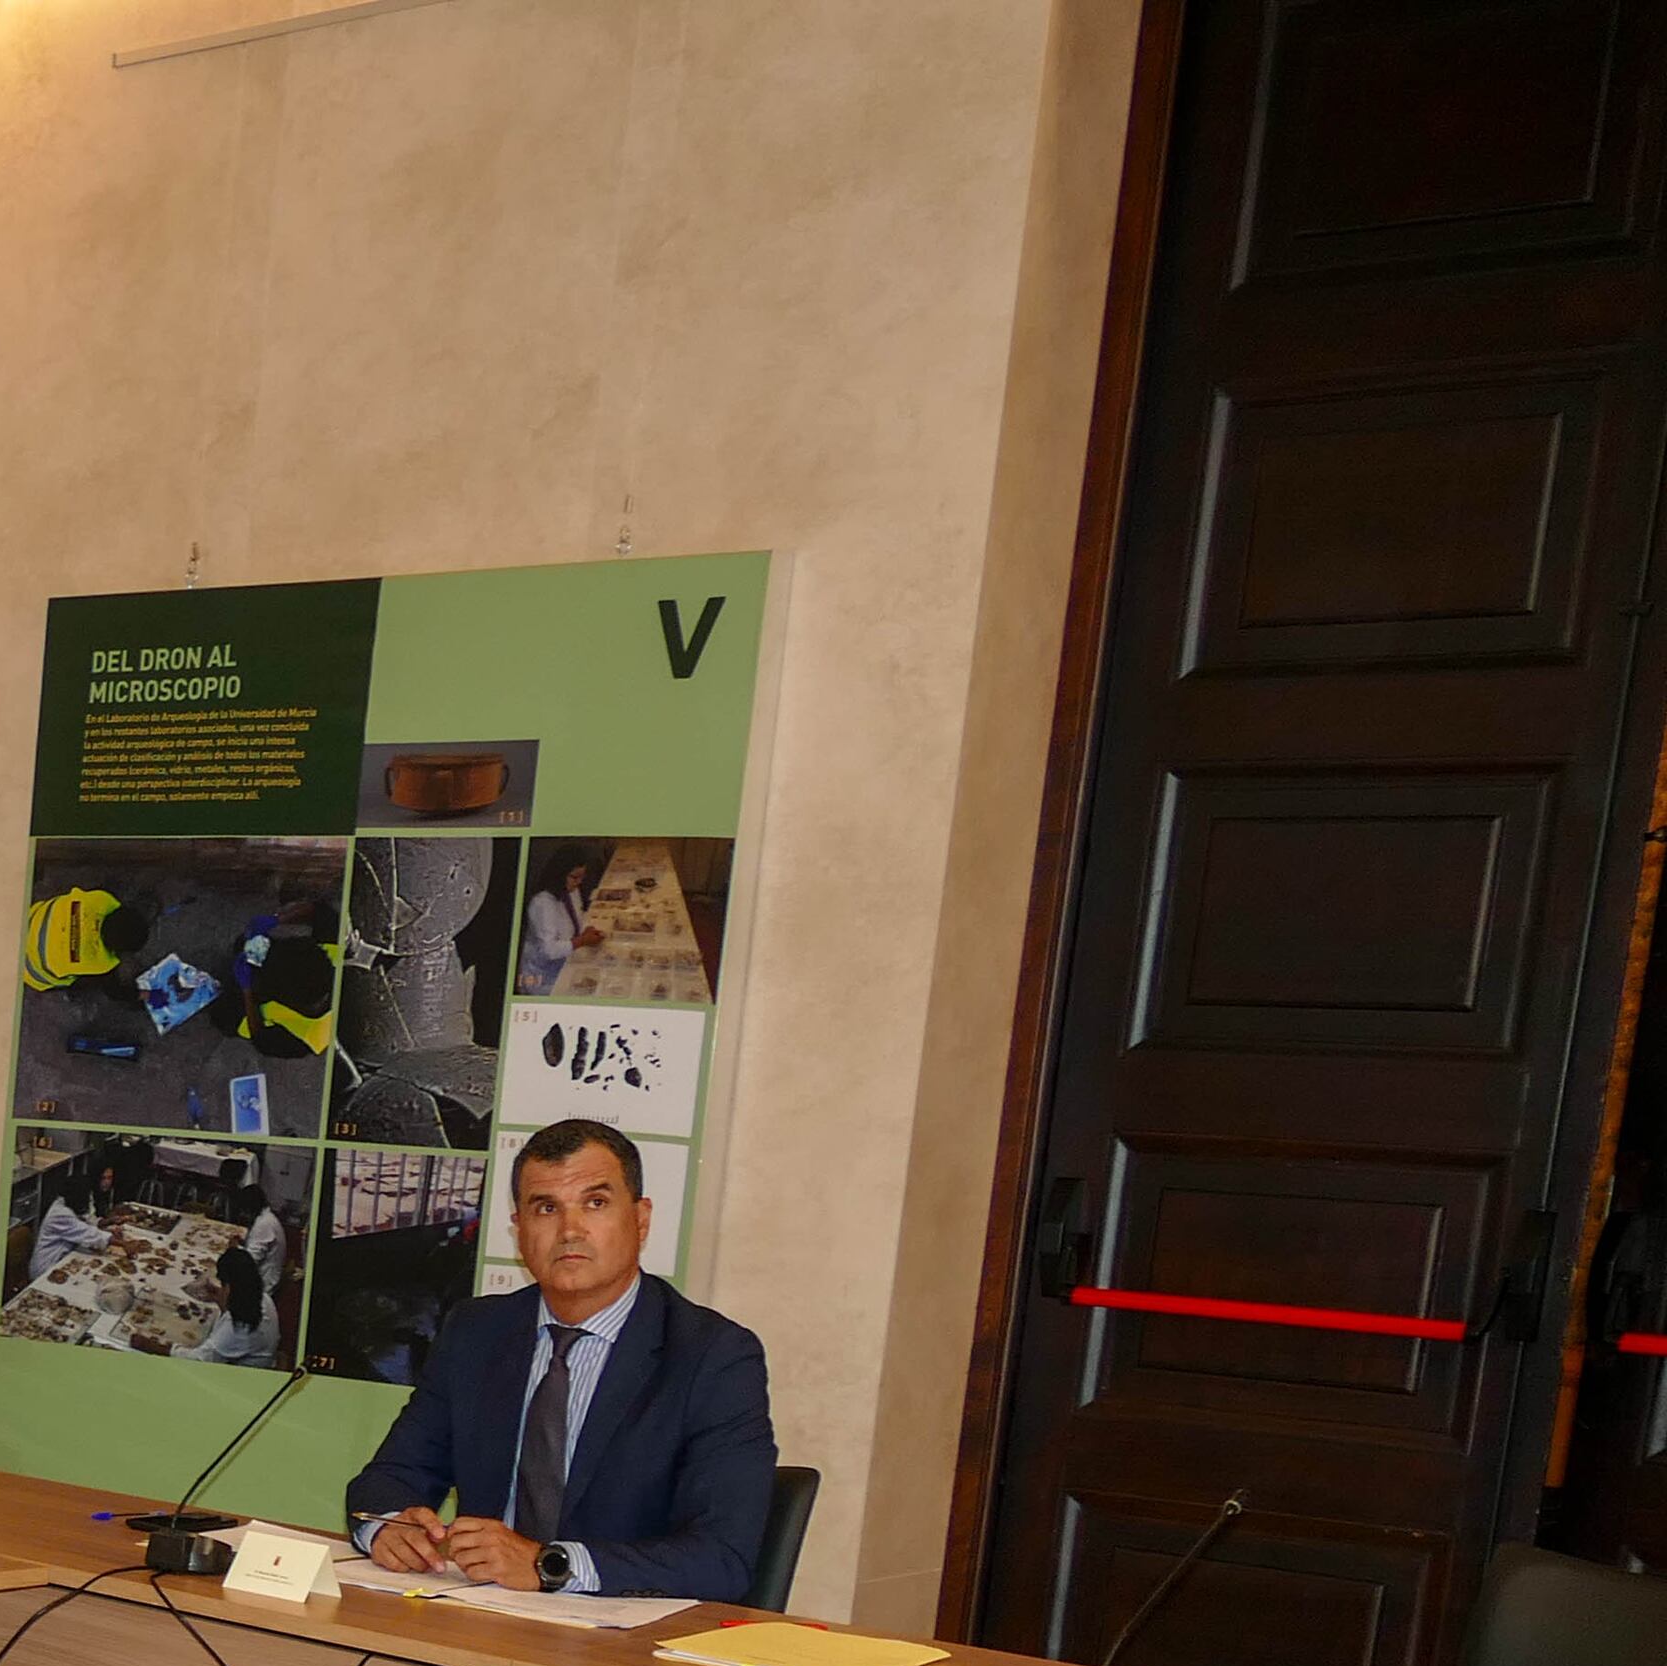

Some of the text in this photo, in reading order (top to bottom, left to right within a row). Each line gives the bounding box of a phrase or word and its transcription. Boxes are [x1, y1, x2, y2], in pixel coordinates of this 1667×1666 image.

[657, 596, 727, 680] V
[92, 644, 237, 673] DEL DRON AL
[88, 675, 241, 704] MICROSCOPIO
